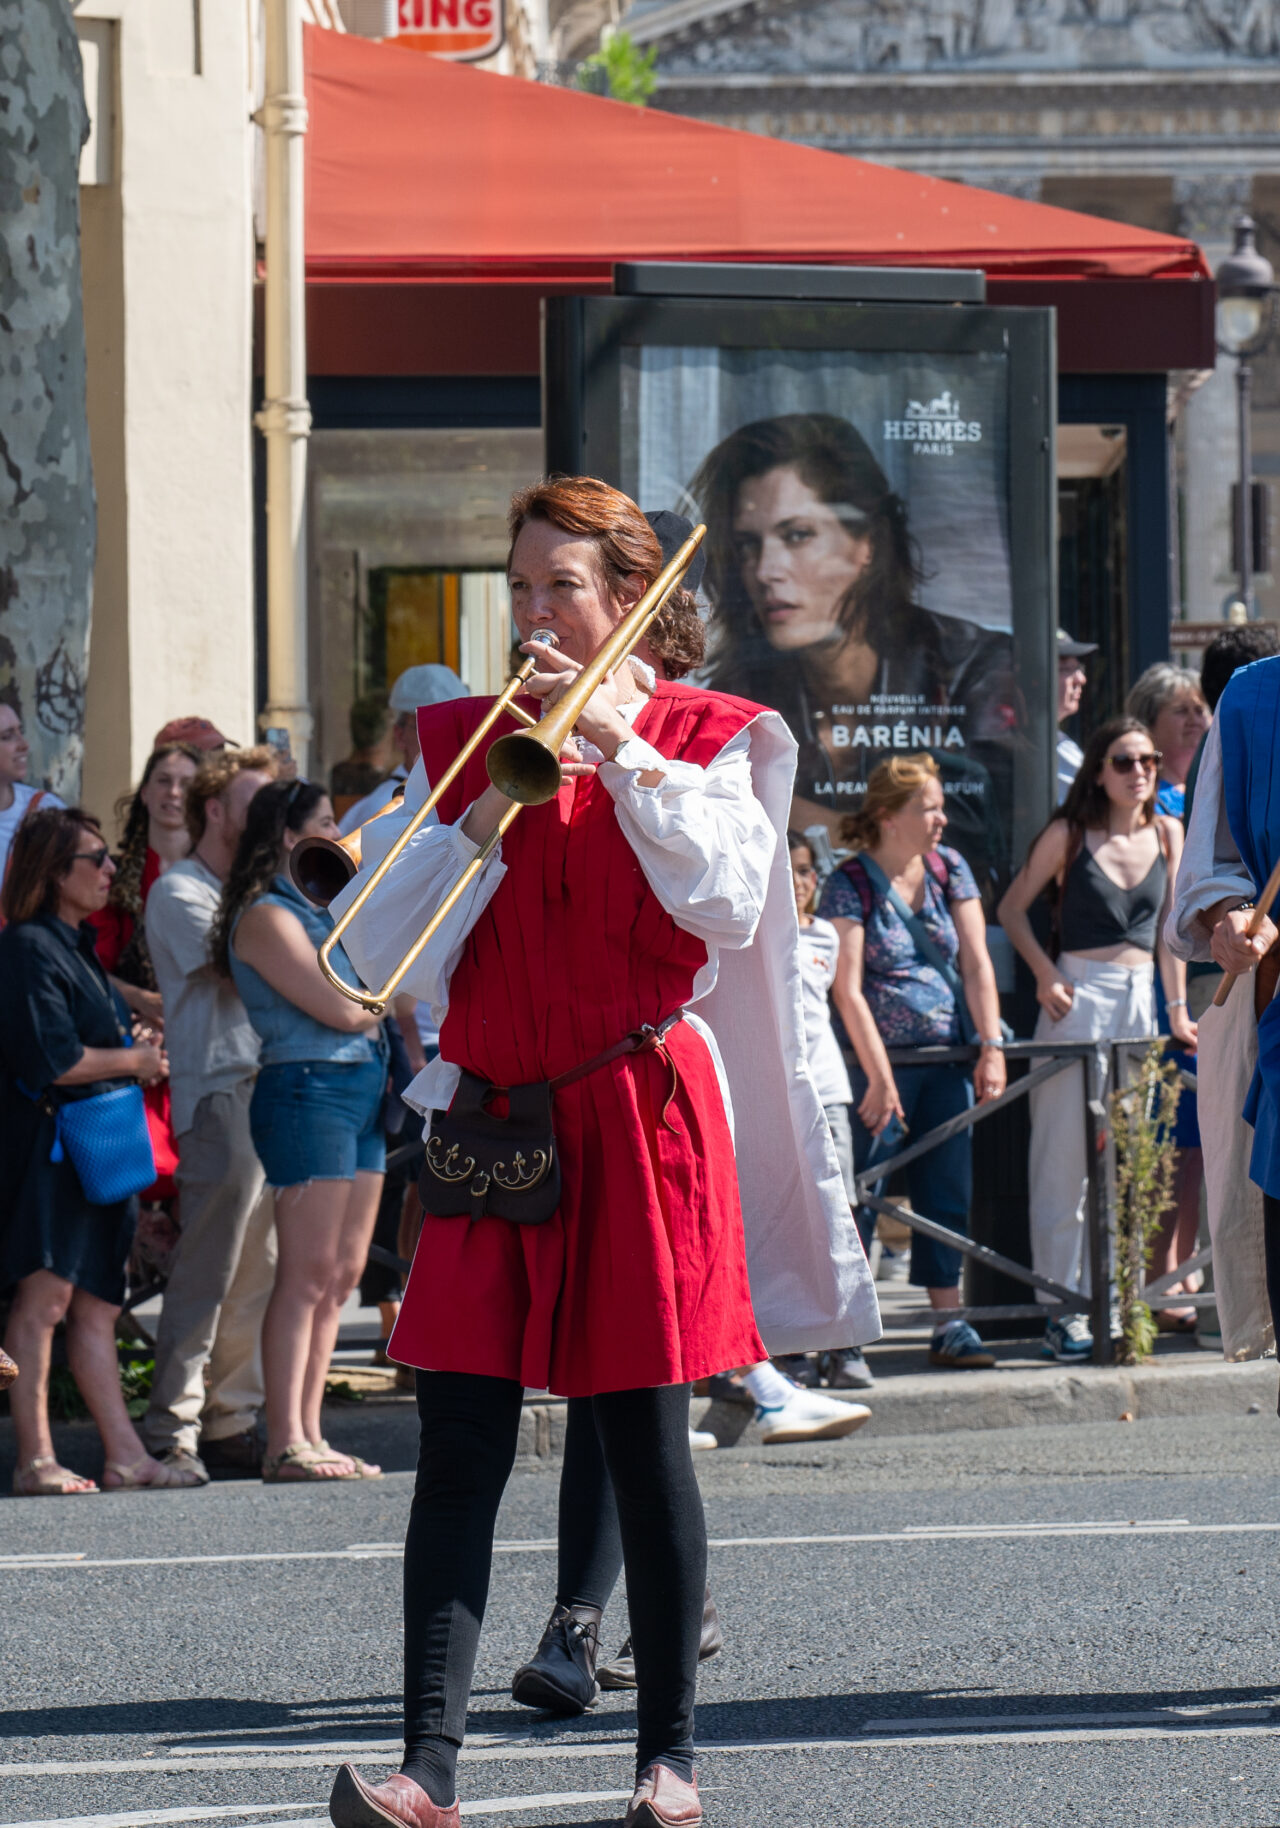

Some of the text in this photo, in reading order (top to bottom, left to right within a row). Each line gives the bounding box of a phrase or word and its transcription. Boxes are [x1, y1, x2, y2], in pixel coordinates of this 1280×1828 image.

[913, 442, 954, 456] PARIS
[870, 694, 926, 705] NOUVELLE
[832, 704, 966, 715] EAU DE PARFUM INTENSE
[832, 719, 966, 748] BARÉNIA
[814, 781, 834, 795] LA
